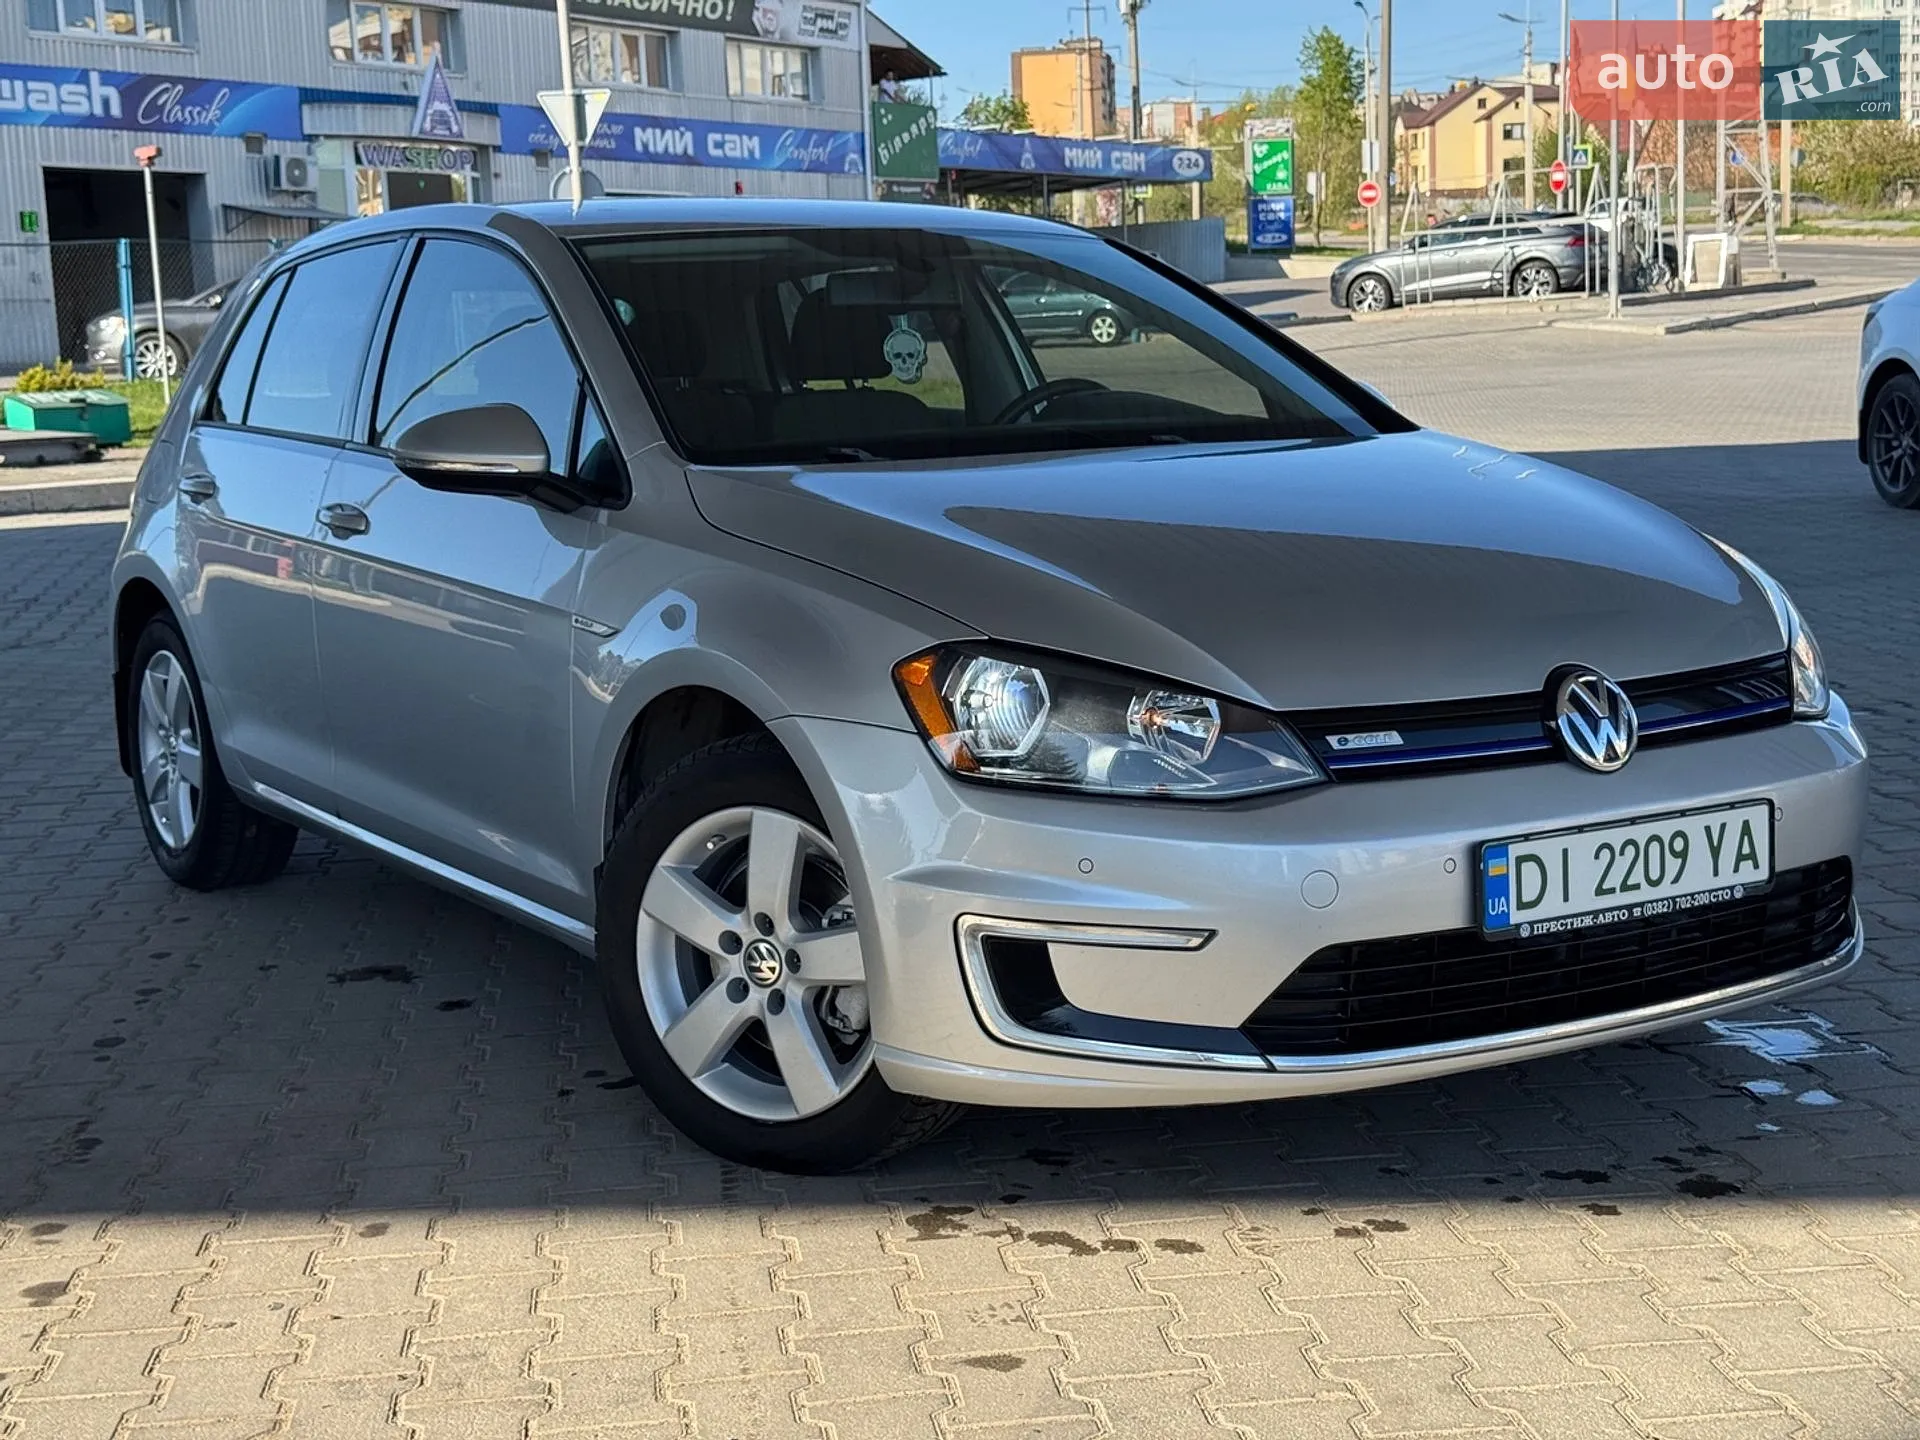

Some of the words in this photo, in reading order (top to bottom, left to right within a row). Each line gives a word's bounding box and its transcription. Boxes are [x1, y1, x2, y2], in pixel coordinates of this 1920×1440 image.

[137, 82, 229, 126] Classik
[358, 143, 475, 172] WASHOP
[774, 129, 836, 170] Comfort
[1515, 847, 1570, 911] DI
[1594, 830, 1690, 896] 2209
[1704, 819, 1760, 877] YA
[1488, 896, 1508, 915] UA
[1533, 909, 1629, 935] ПРЕСТИЖ-АВТО
[1643, 899, 1673, 916] (0382)
